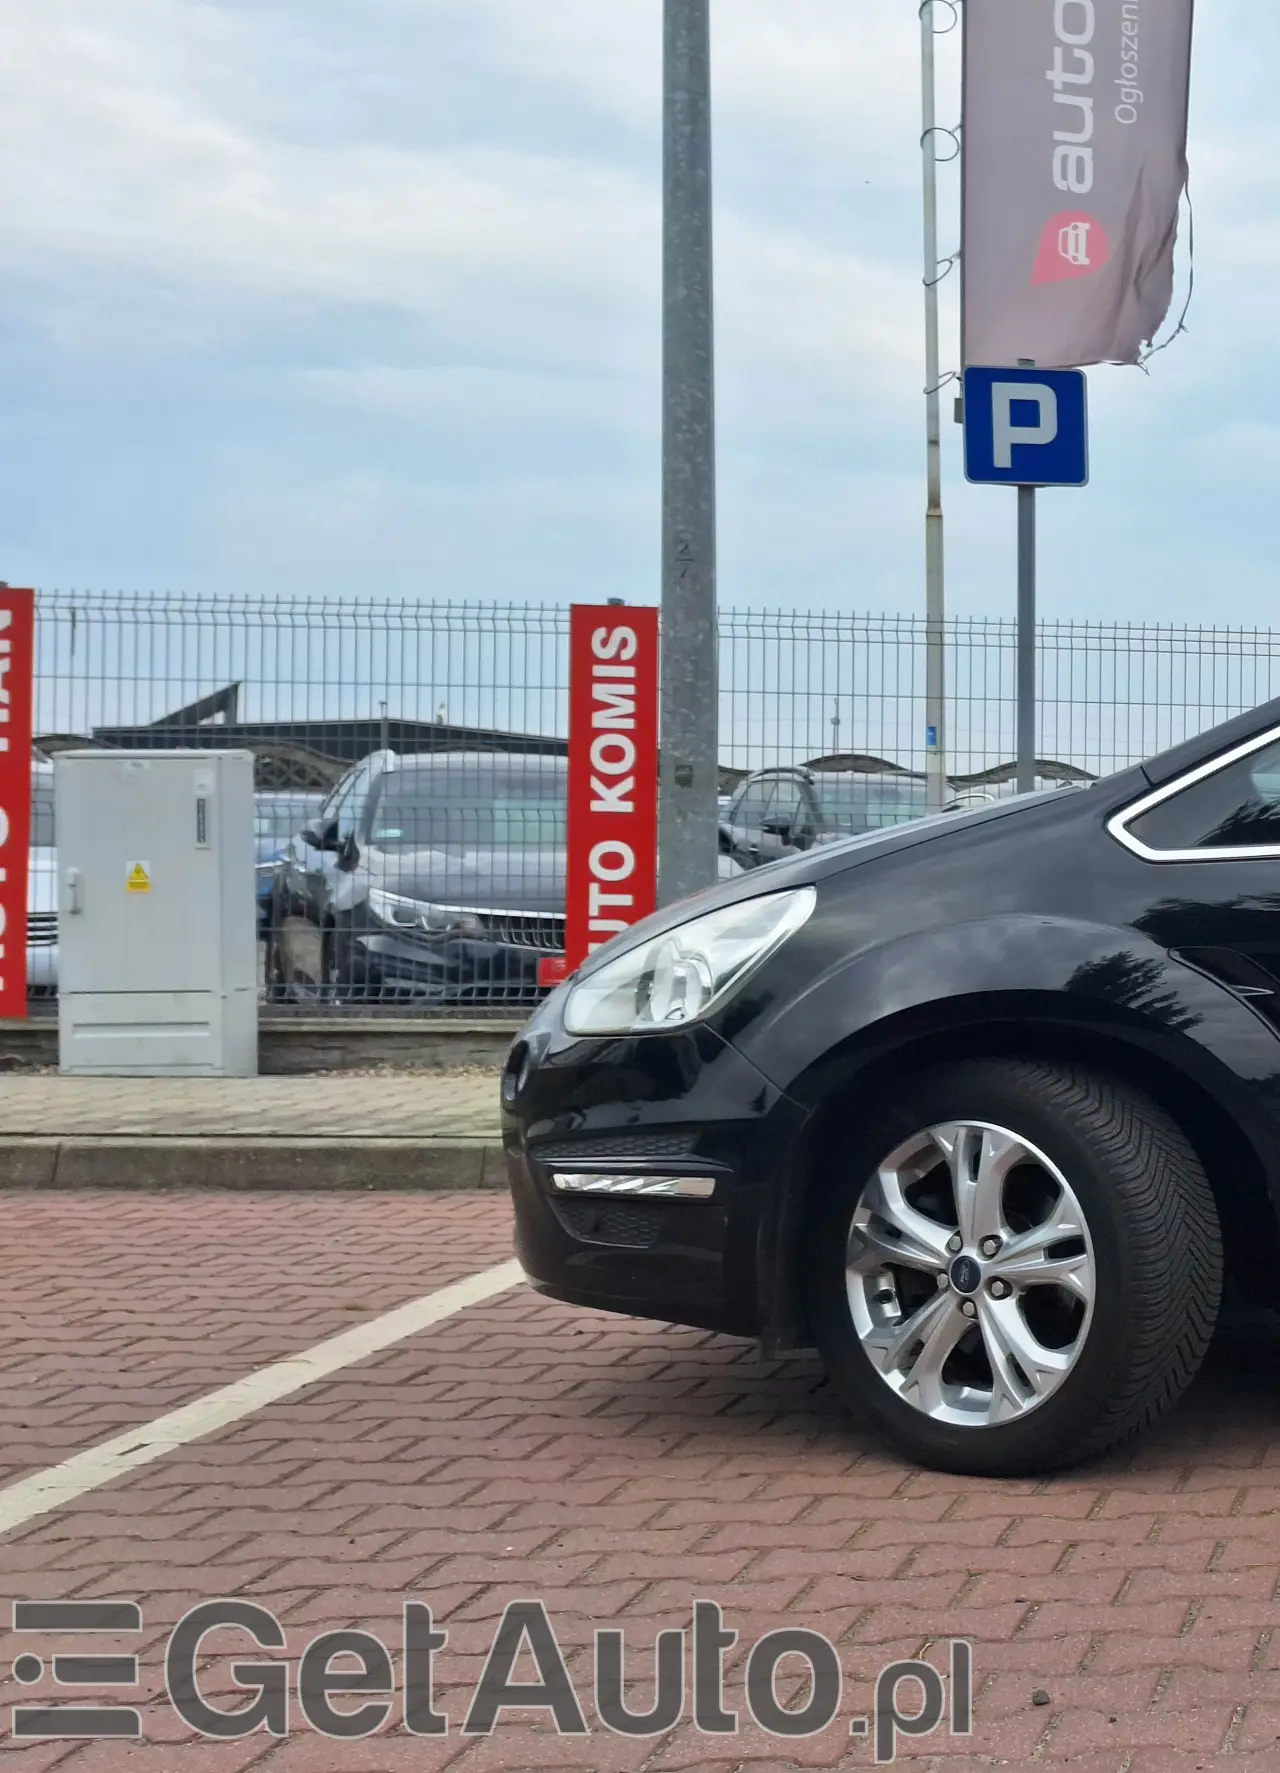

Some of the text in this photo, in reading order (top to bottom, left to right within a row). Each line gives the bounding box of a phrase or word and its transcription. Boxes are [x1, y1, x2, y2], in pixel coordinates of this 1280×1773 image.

[1045, 0, 1095, 194] auto
[991, 381, 1058, 469] P
[589, 625, 637, 813] KOMIS
